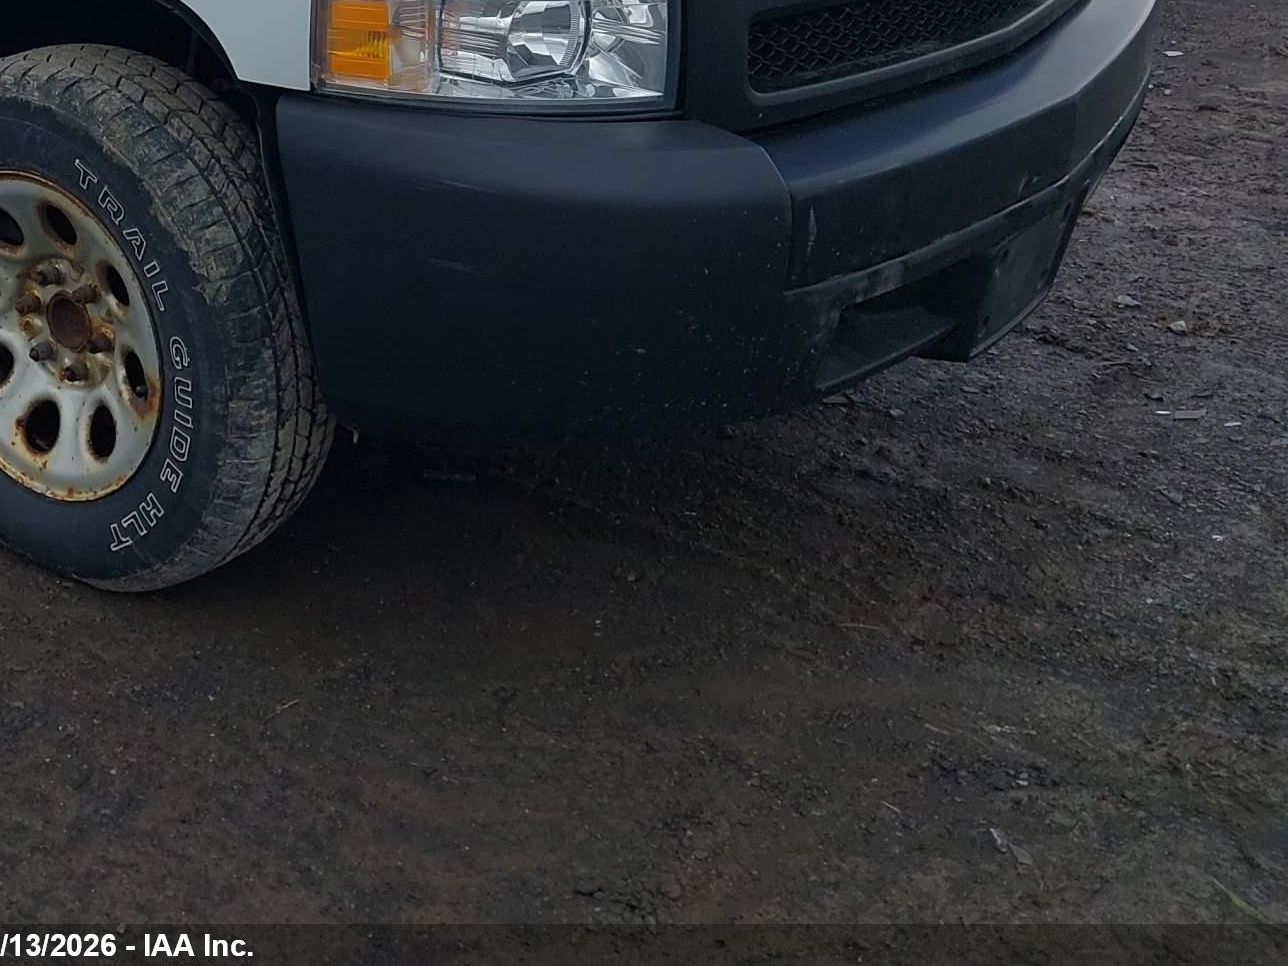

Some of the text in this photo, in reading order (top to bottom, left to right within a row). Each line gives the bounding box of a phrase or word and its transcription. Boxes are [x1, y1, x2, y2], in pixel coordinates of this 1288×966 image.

[73, 157, 196, 553] TRAIL GUIDE HLT
